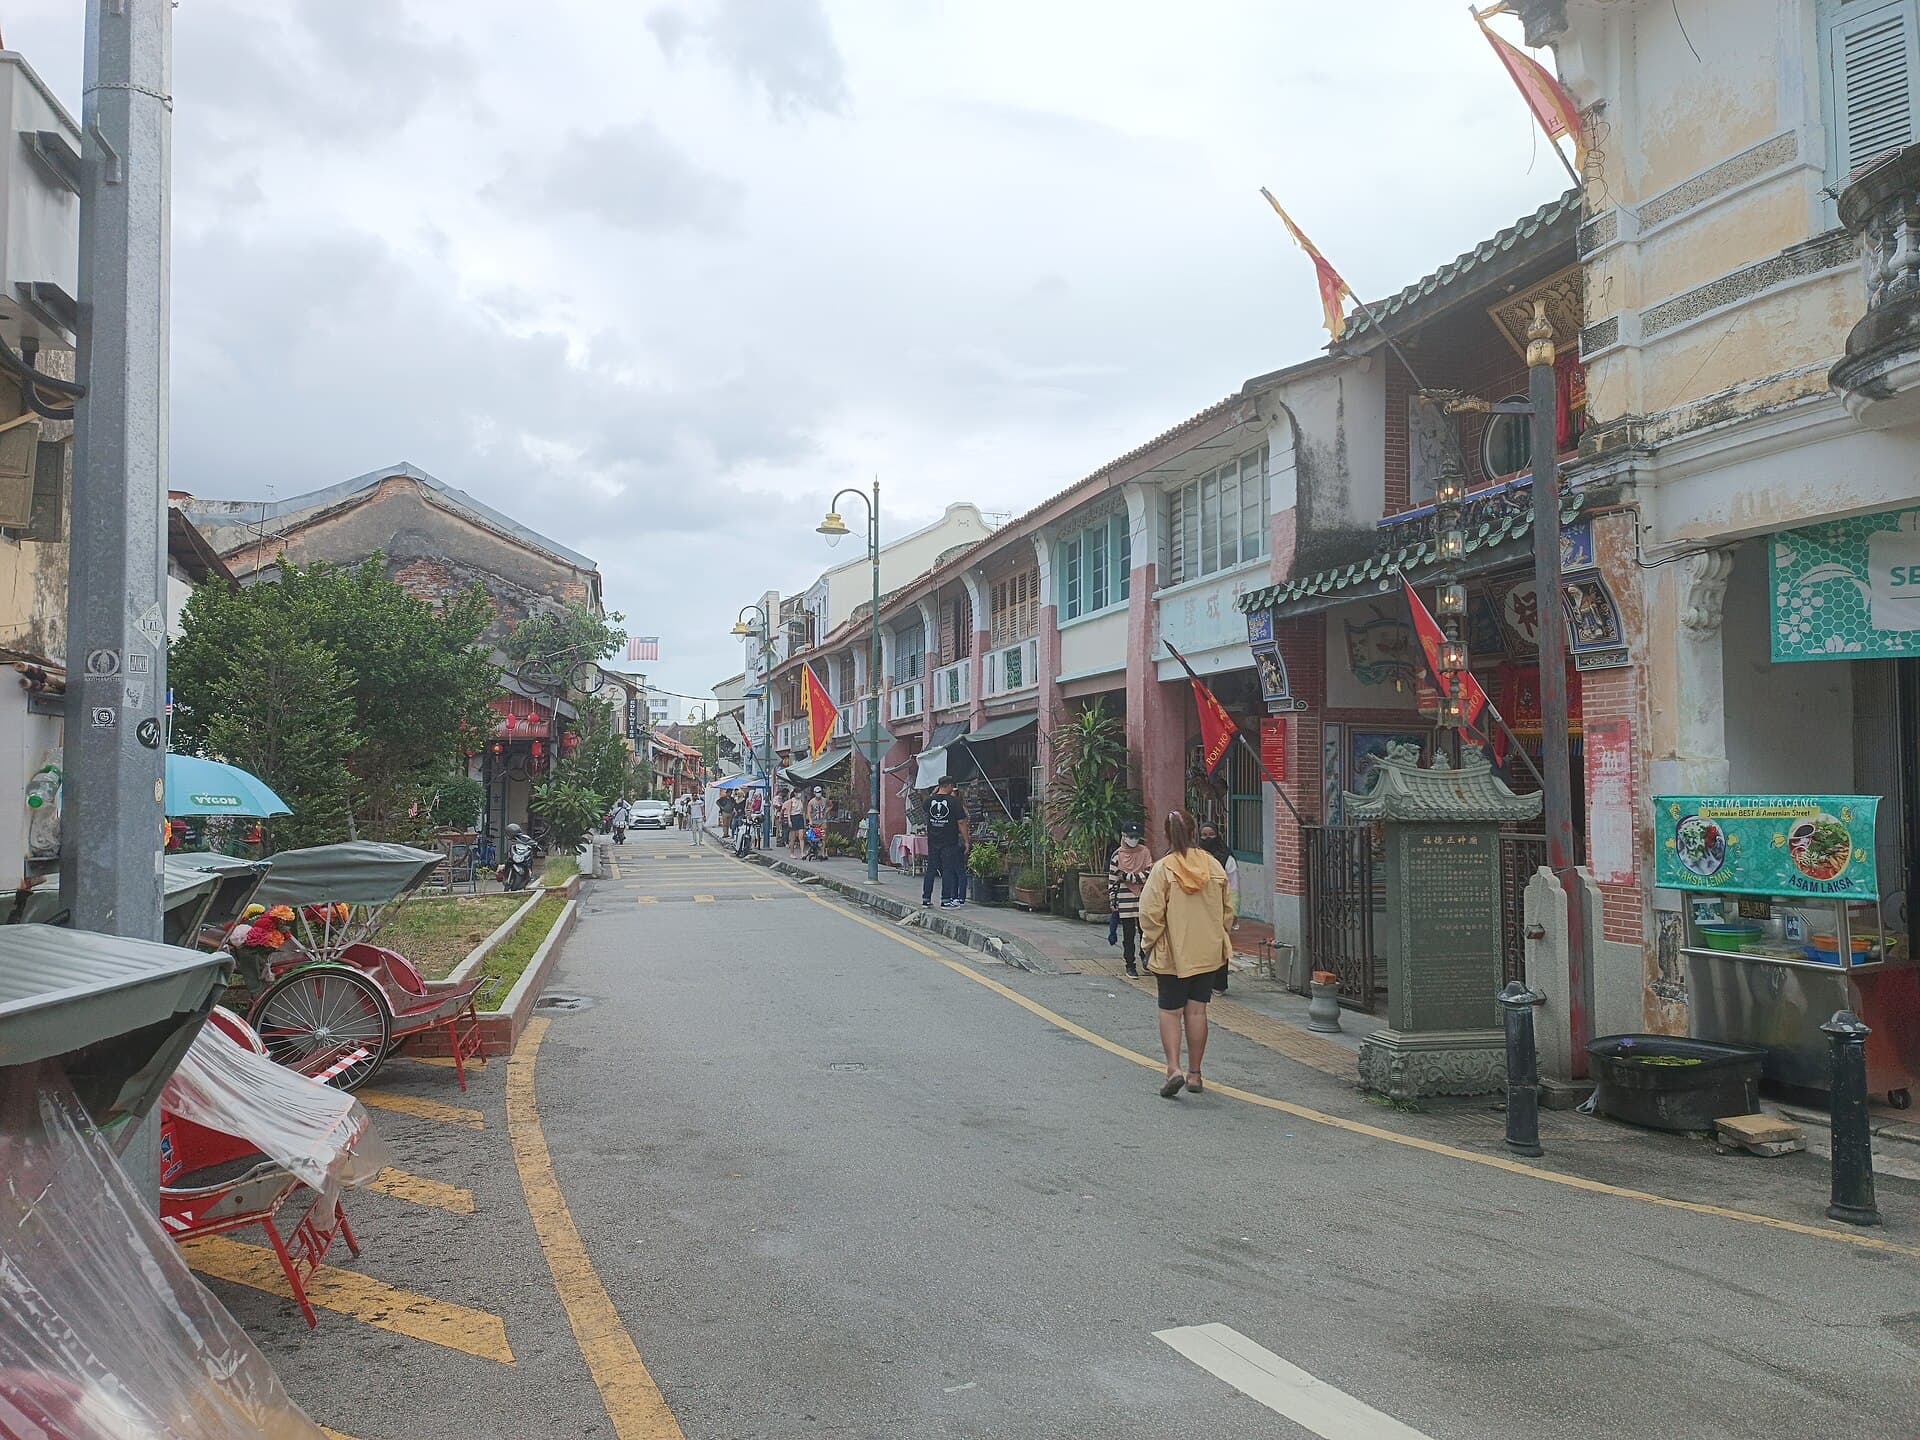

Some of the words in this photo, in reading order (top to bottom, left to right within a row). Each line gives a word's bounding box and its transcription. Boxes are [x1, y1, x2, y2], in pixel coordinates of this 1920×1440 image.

[1206, 746, 1221, 765] POH
[1701, 799, 1741, 808] SERIMA
[1769, 798, 1817, 808] KACANG
[1676, 865, 1703, 886] LAKSA
[1706, 867, 1734, 887] LEMAK
[1788, 874, 1818, 892] ASAM
[1821, 877, 1854, 893] LAKSA
